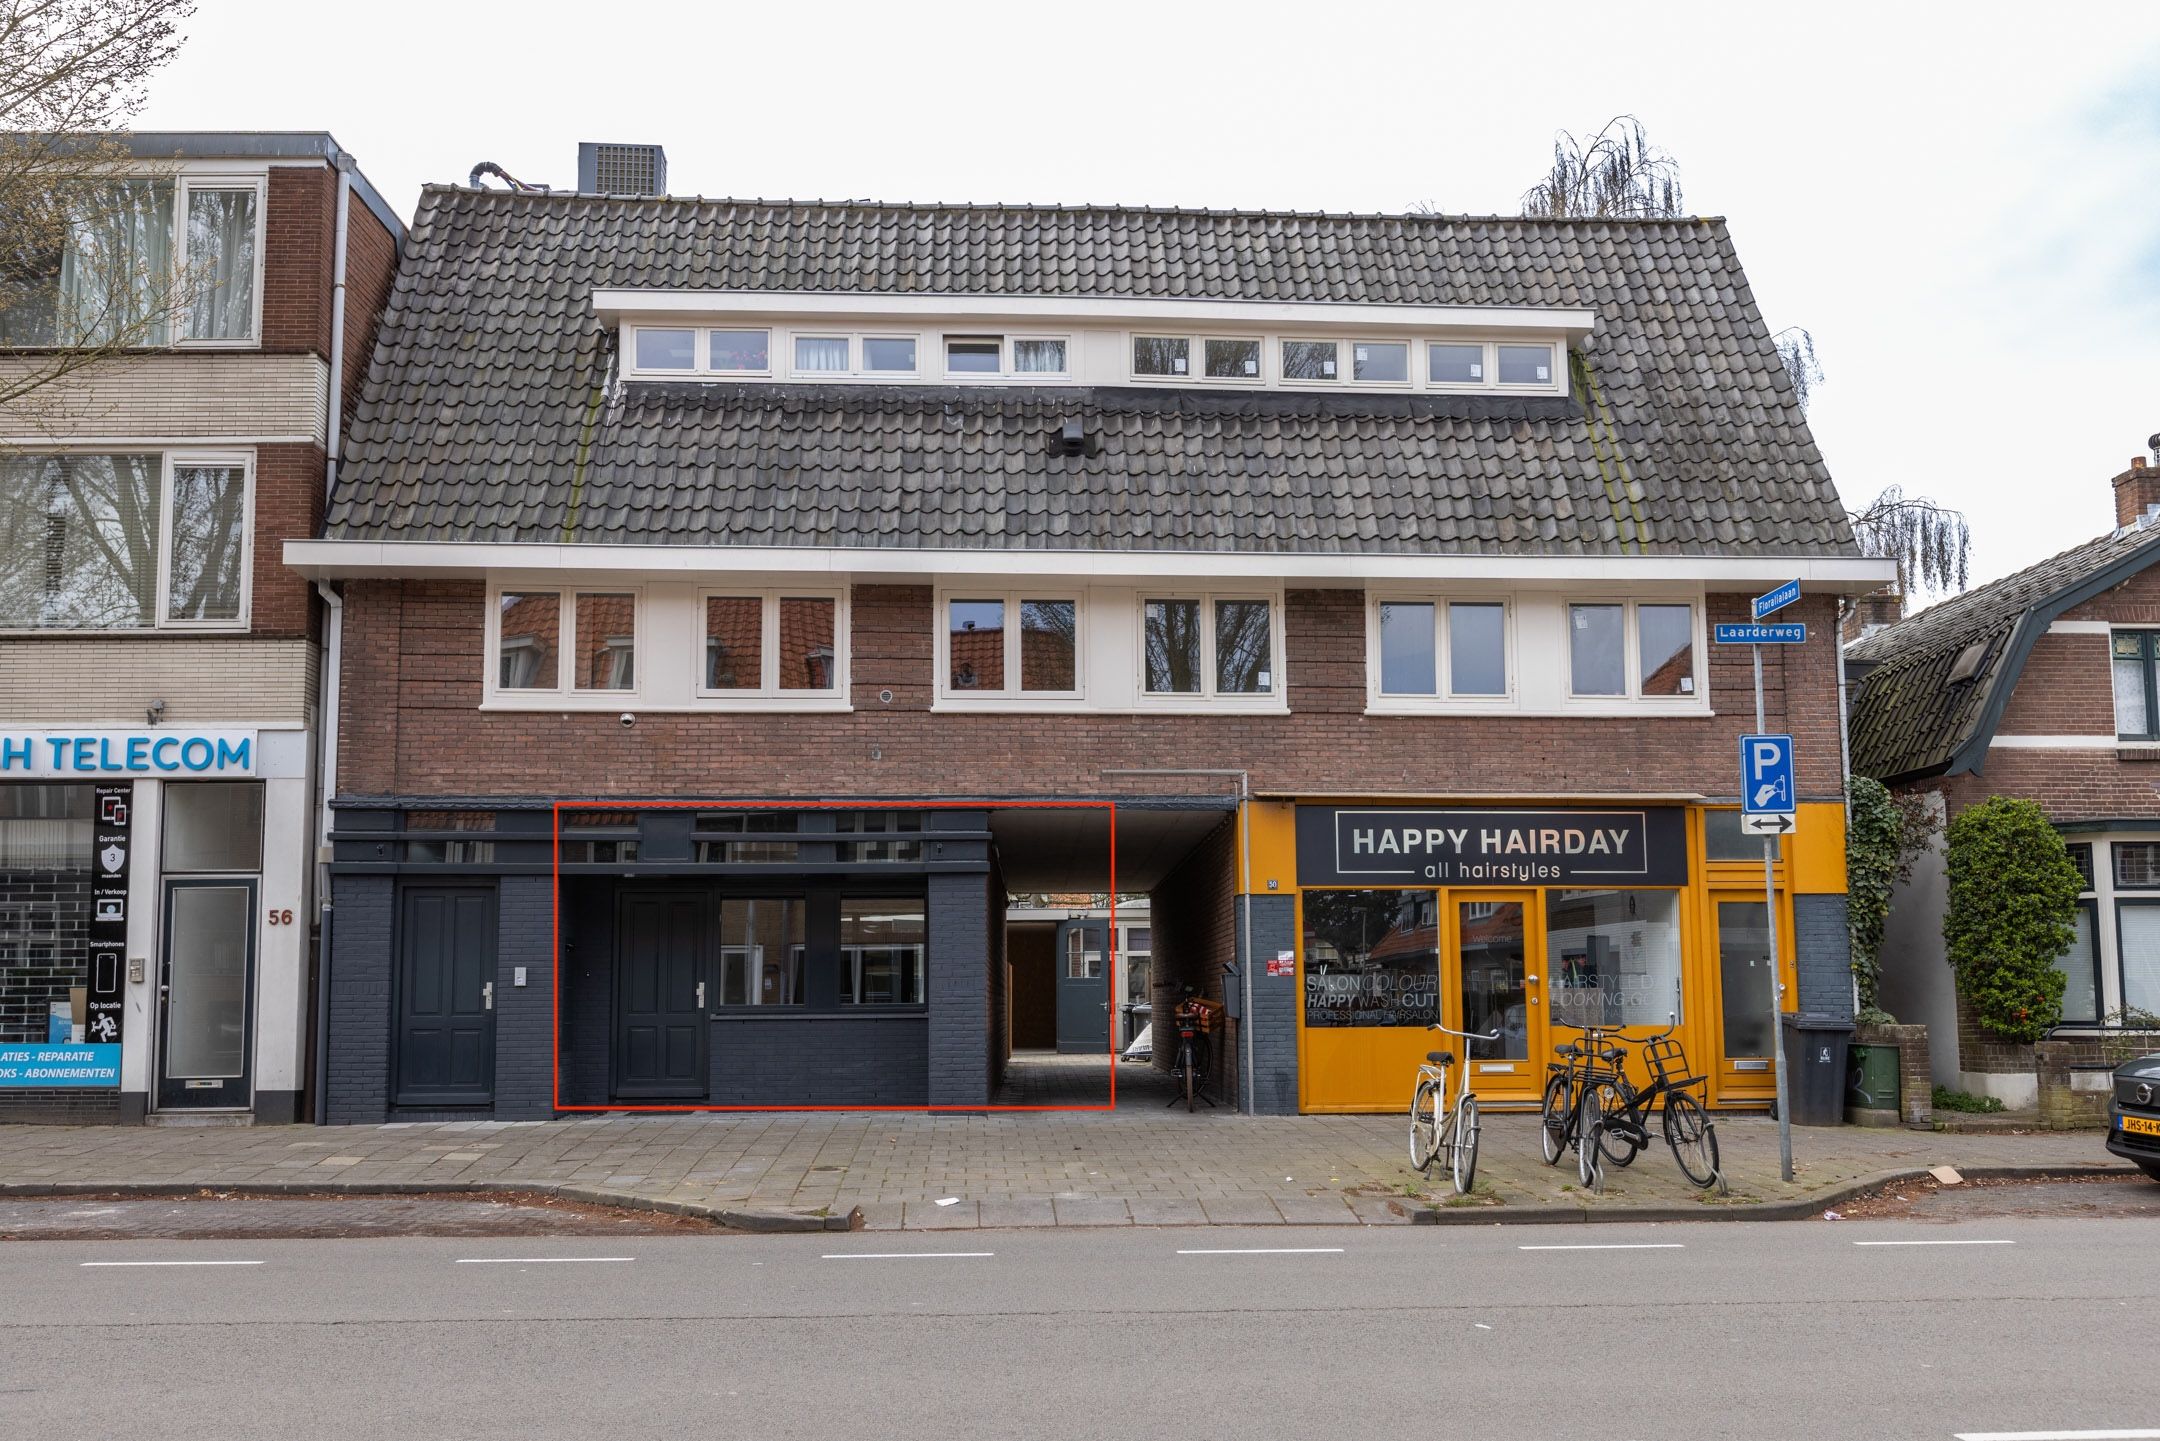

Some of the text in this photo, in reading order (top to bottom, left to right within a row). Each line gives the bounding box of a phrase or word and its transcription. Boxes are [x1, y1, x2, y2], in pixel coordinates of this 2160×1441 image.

[1758, 586, 1797, 613] Floralialaan
[1719, 626, 1802, 640] Laarderweg
[0, 736, 252, 771] H TELECOM
[1753, 742, 1782, 781] P
[96, 786, 132, 796] Repair Center
[98, 835, 126, 843] Garantie
[1353, 828, 1630, 854] HAPPY HAIRDAY
[110, 853, 116, 862] 3
[1424, 862, 1561, 881] all hairstyles
[105, 888, 127, 898] Verkoop
[268, 909, 293, 926] 56
[90, 941, 125, 950] Smartphones
[1306, 974, 1438, 991] SALON COLOUR
[1307, 993, 1438, 1008] HAPPY WASH CUT
[1551, 992, 1625, 1006] LOOKING
[90, 1002, 99, 1011] Op
[1307, 1010, 1381, 1020] PROFESSIONAL
[37, 1051, 95, 1061] REPARATIE
[24, 1068, 116, 1078] ABONNEMENTEN
